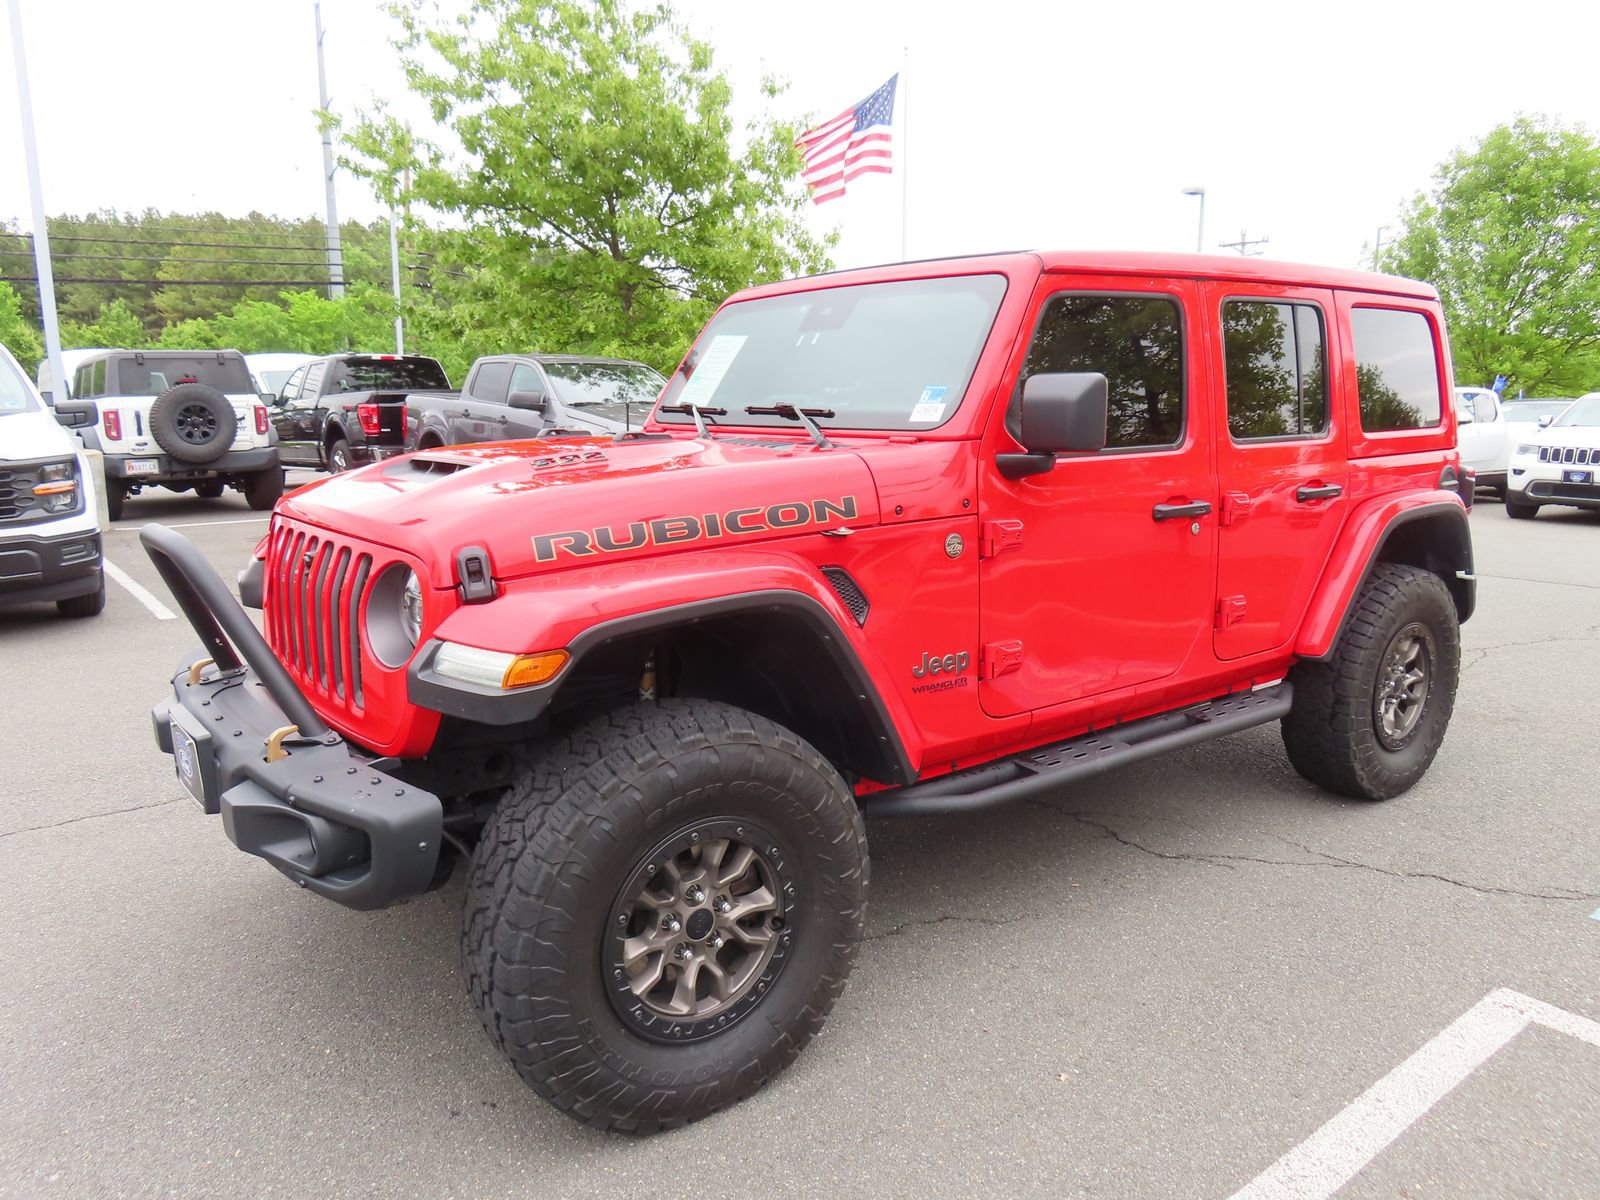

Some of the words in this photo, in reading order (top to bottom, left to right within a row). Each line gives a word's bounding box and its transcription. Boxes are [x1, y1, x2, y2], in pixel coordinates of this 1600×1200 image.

[529, 451, 608, 470] 392
[530, 495, 857, 563] RUBICON
[912, 651, 969, 677] Jeep
[912, 677, 967, 693] WRANGLER
